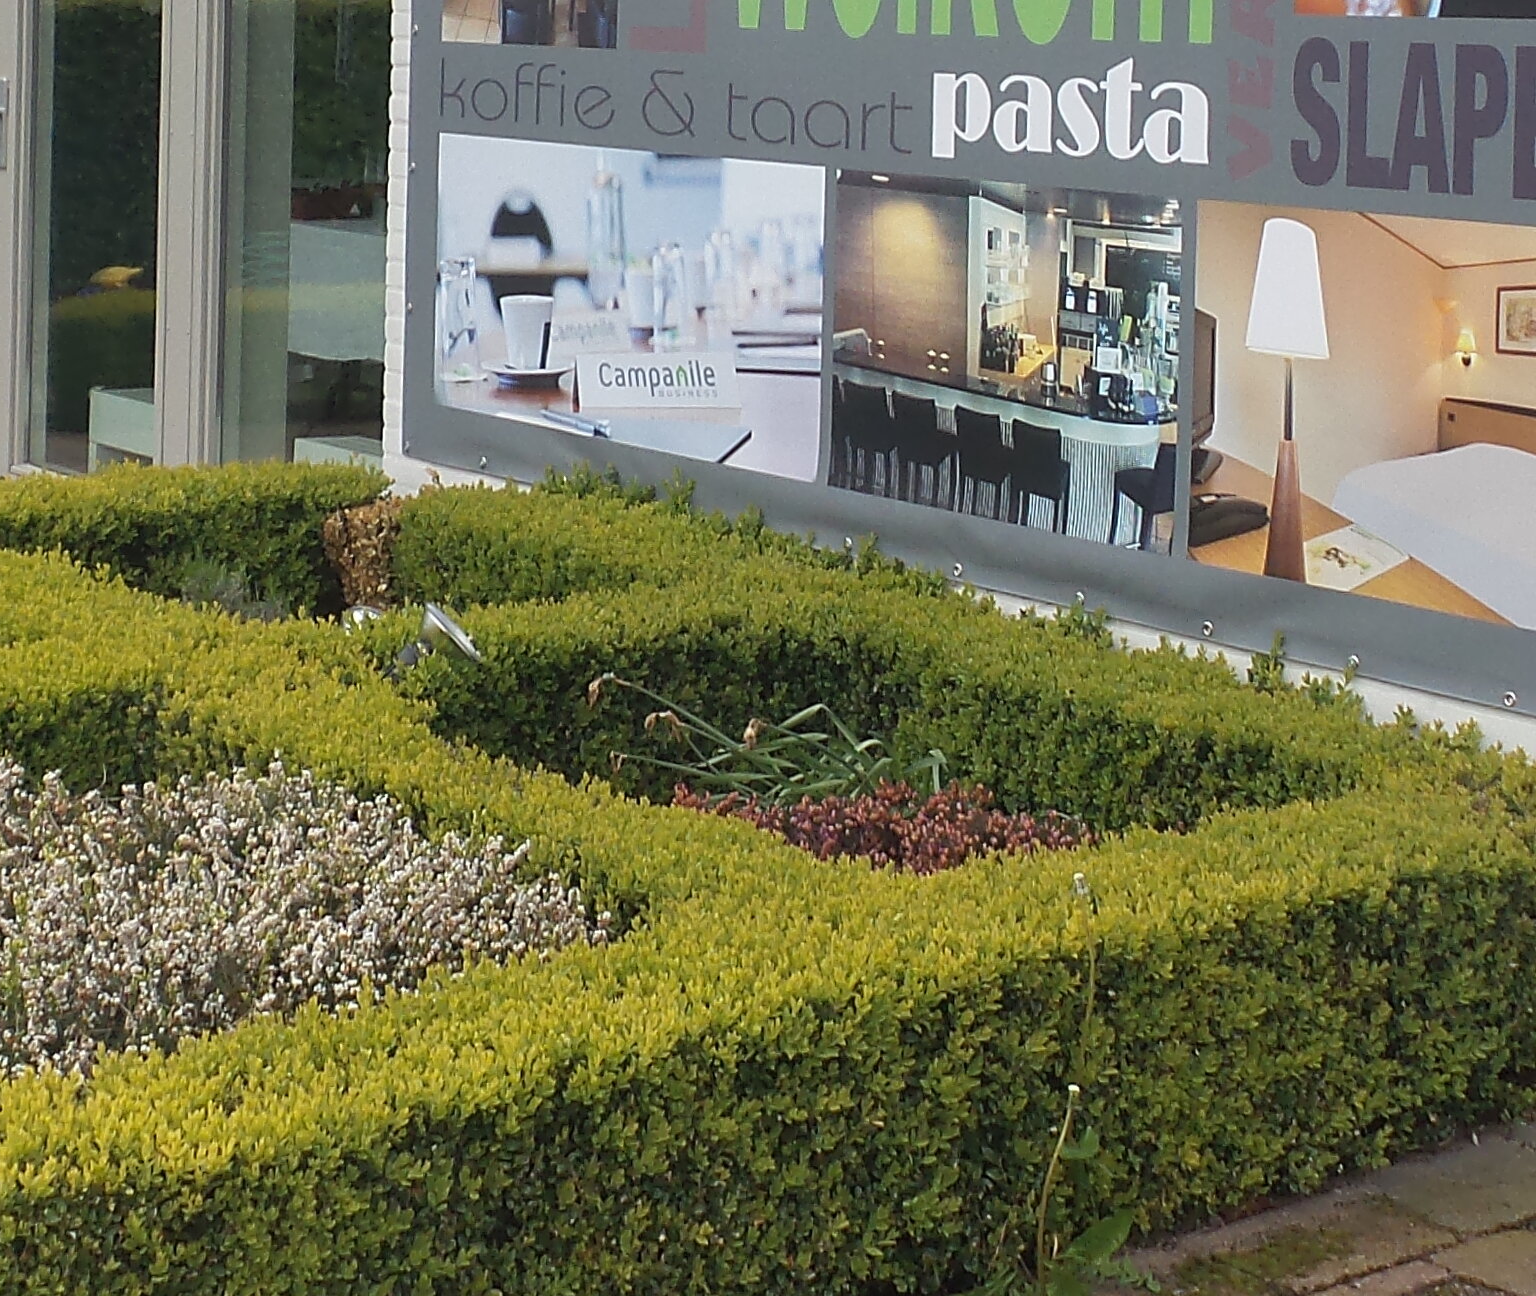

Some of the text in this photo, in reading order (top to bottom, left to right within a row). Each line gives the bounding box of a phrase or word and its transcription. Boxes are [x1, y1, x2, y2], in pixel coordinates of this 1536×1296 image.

[440, 58, 914, 155] koffie & taart
[931, 58, 1210, 165] pasta
[599, 360, 715, 397] Campanile
